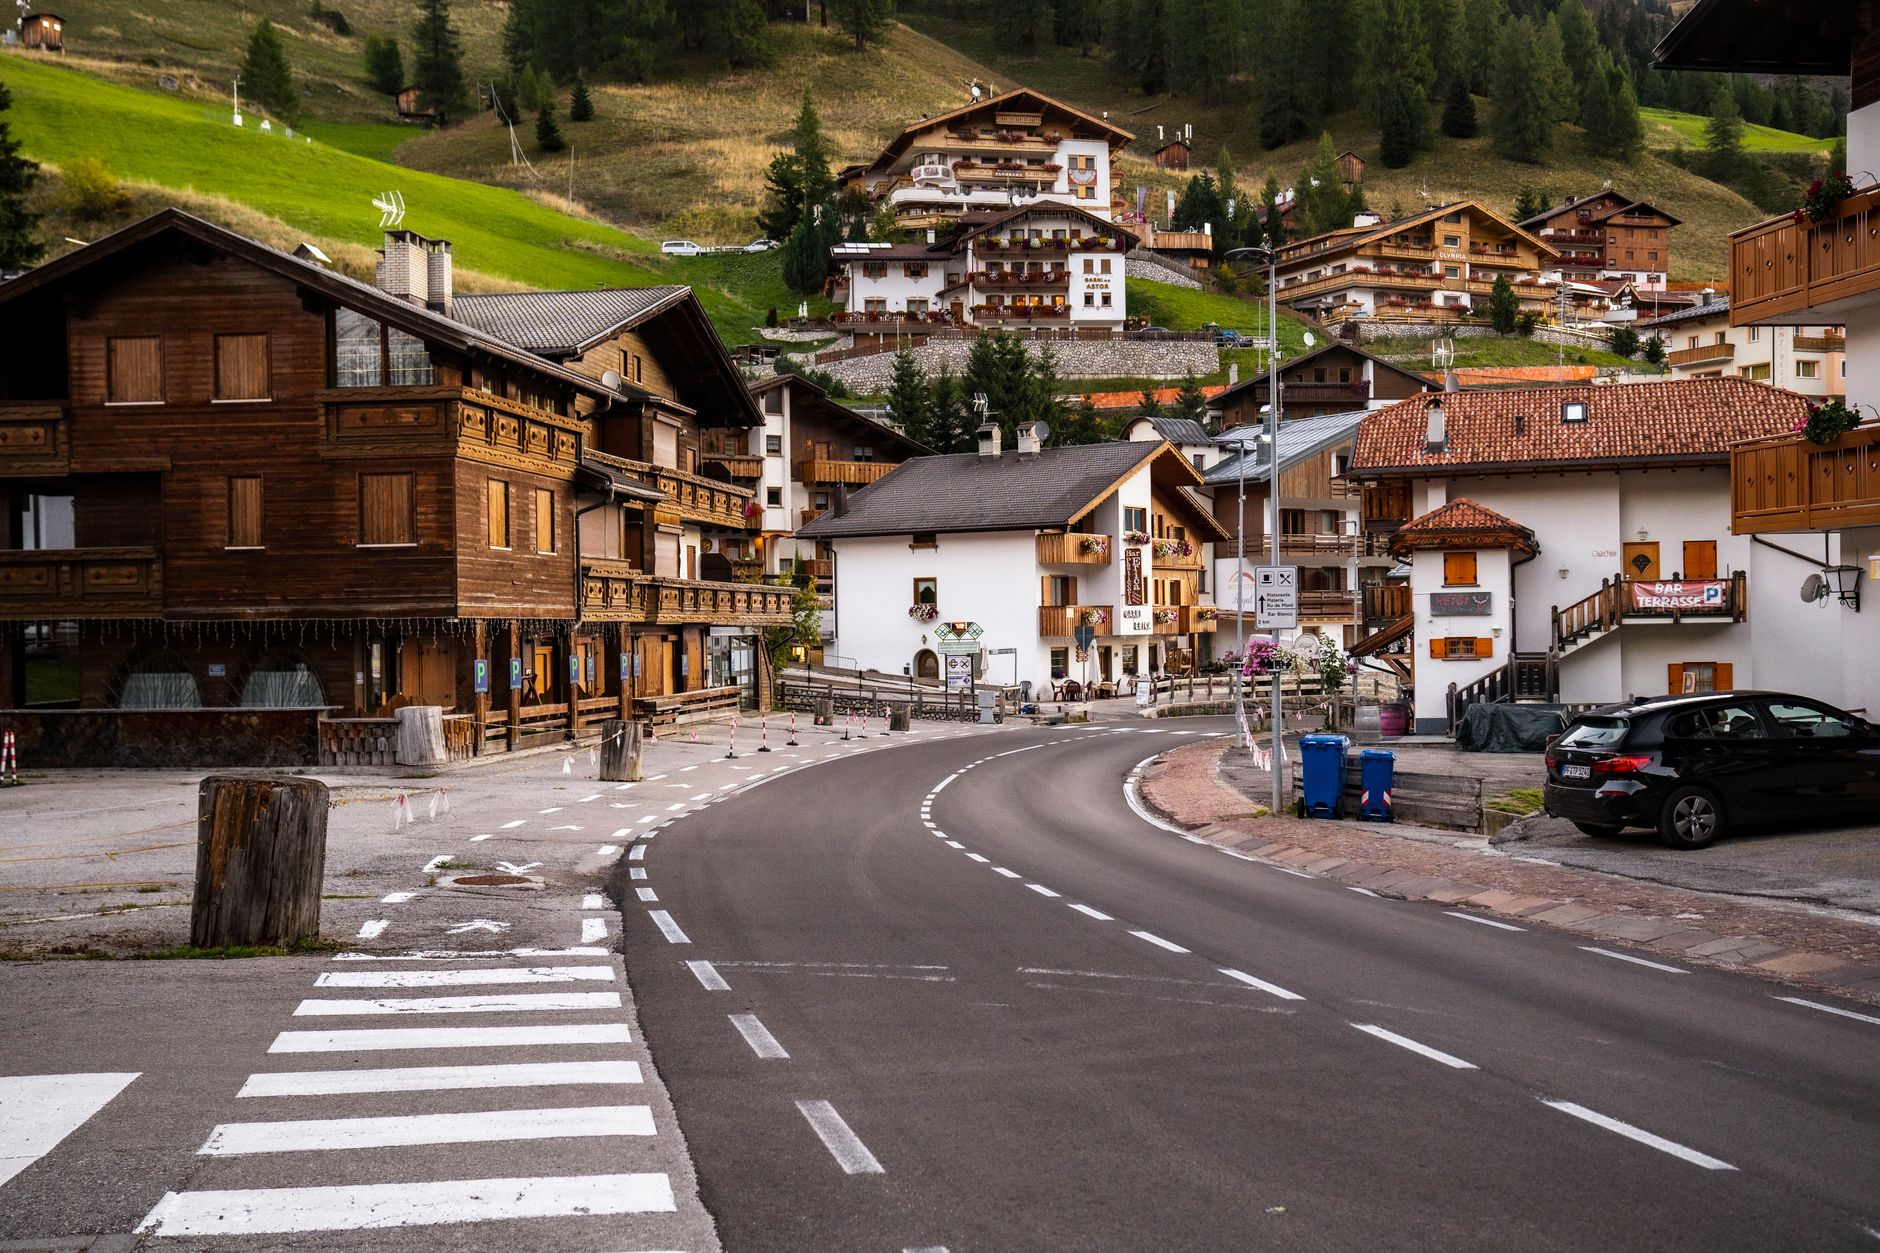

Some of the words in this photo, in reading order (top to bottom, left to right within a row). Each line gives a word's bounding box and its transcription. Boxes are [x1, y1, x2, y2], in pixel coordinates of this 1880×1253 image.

[1439, 251, 1467, 260] OLYMPIA
[1132, 557, 1141, 591] Erica
[1655, 583, 1684, 595] BAR
[1636, 596, 1702, 608] TERRASSE
[477, 662, 485, 684] P
[511, 660, 520, 681] P
